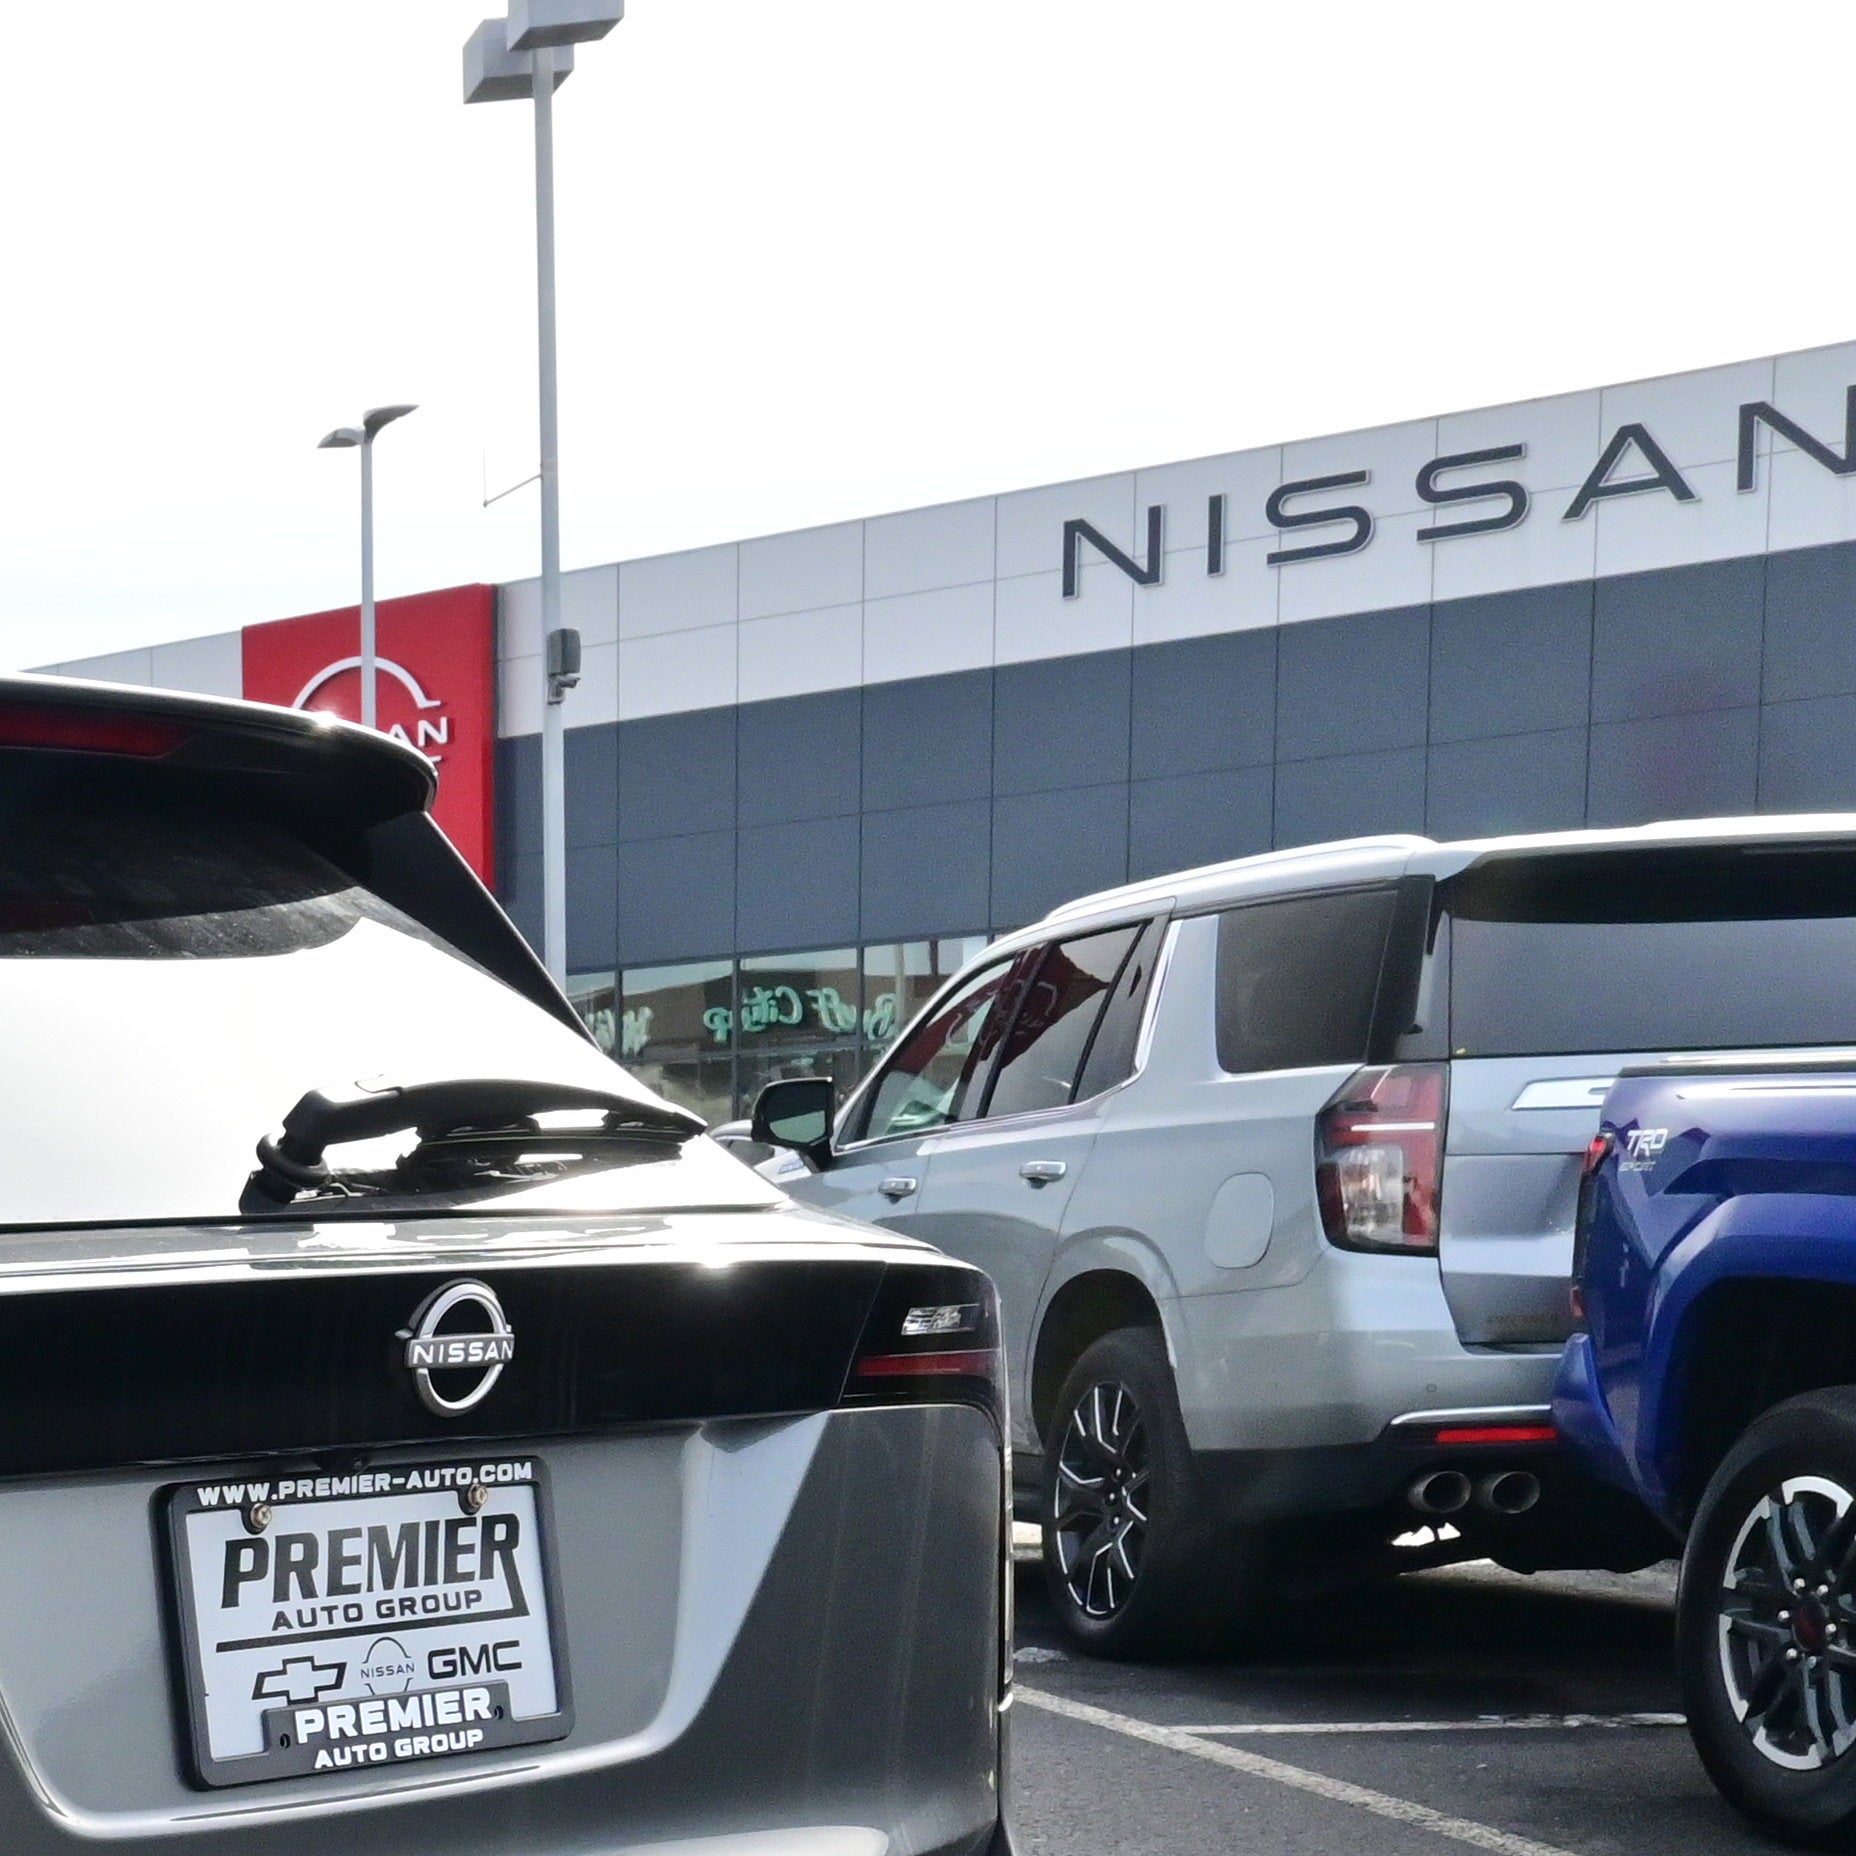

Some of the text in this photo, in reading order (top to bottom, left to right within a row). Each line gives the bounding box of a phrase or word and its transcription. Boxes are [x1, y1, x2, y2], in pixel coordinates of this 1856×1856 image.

[1061, 384, 1856, 599] NISSAN
[1626, 1127, 1669, 1158] TRD
[412, 1340, 514, 1364] NISSAN
[197, 1461, 533, 1506] WWW.PREMIER-AUTO.COM
[220, 1512, 529, 1610] PREMIER
[271, 1588, 483, 1632] AUTO GROUP
[360, 1661, 415, 1680] NISSAN
[427, 1640, 523, 1680] GMC
[294, 1686, 493, 1745] PREMIER
[313, 1728, 484, 1770] AUTO GROUP
